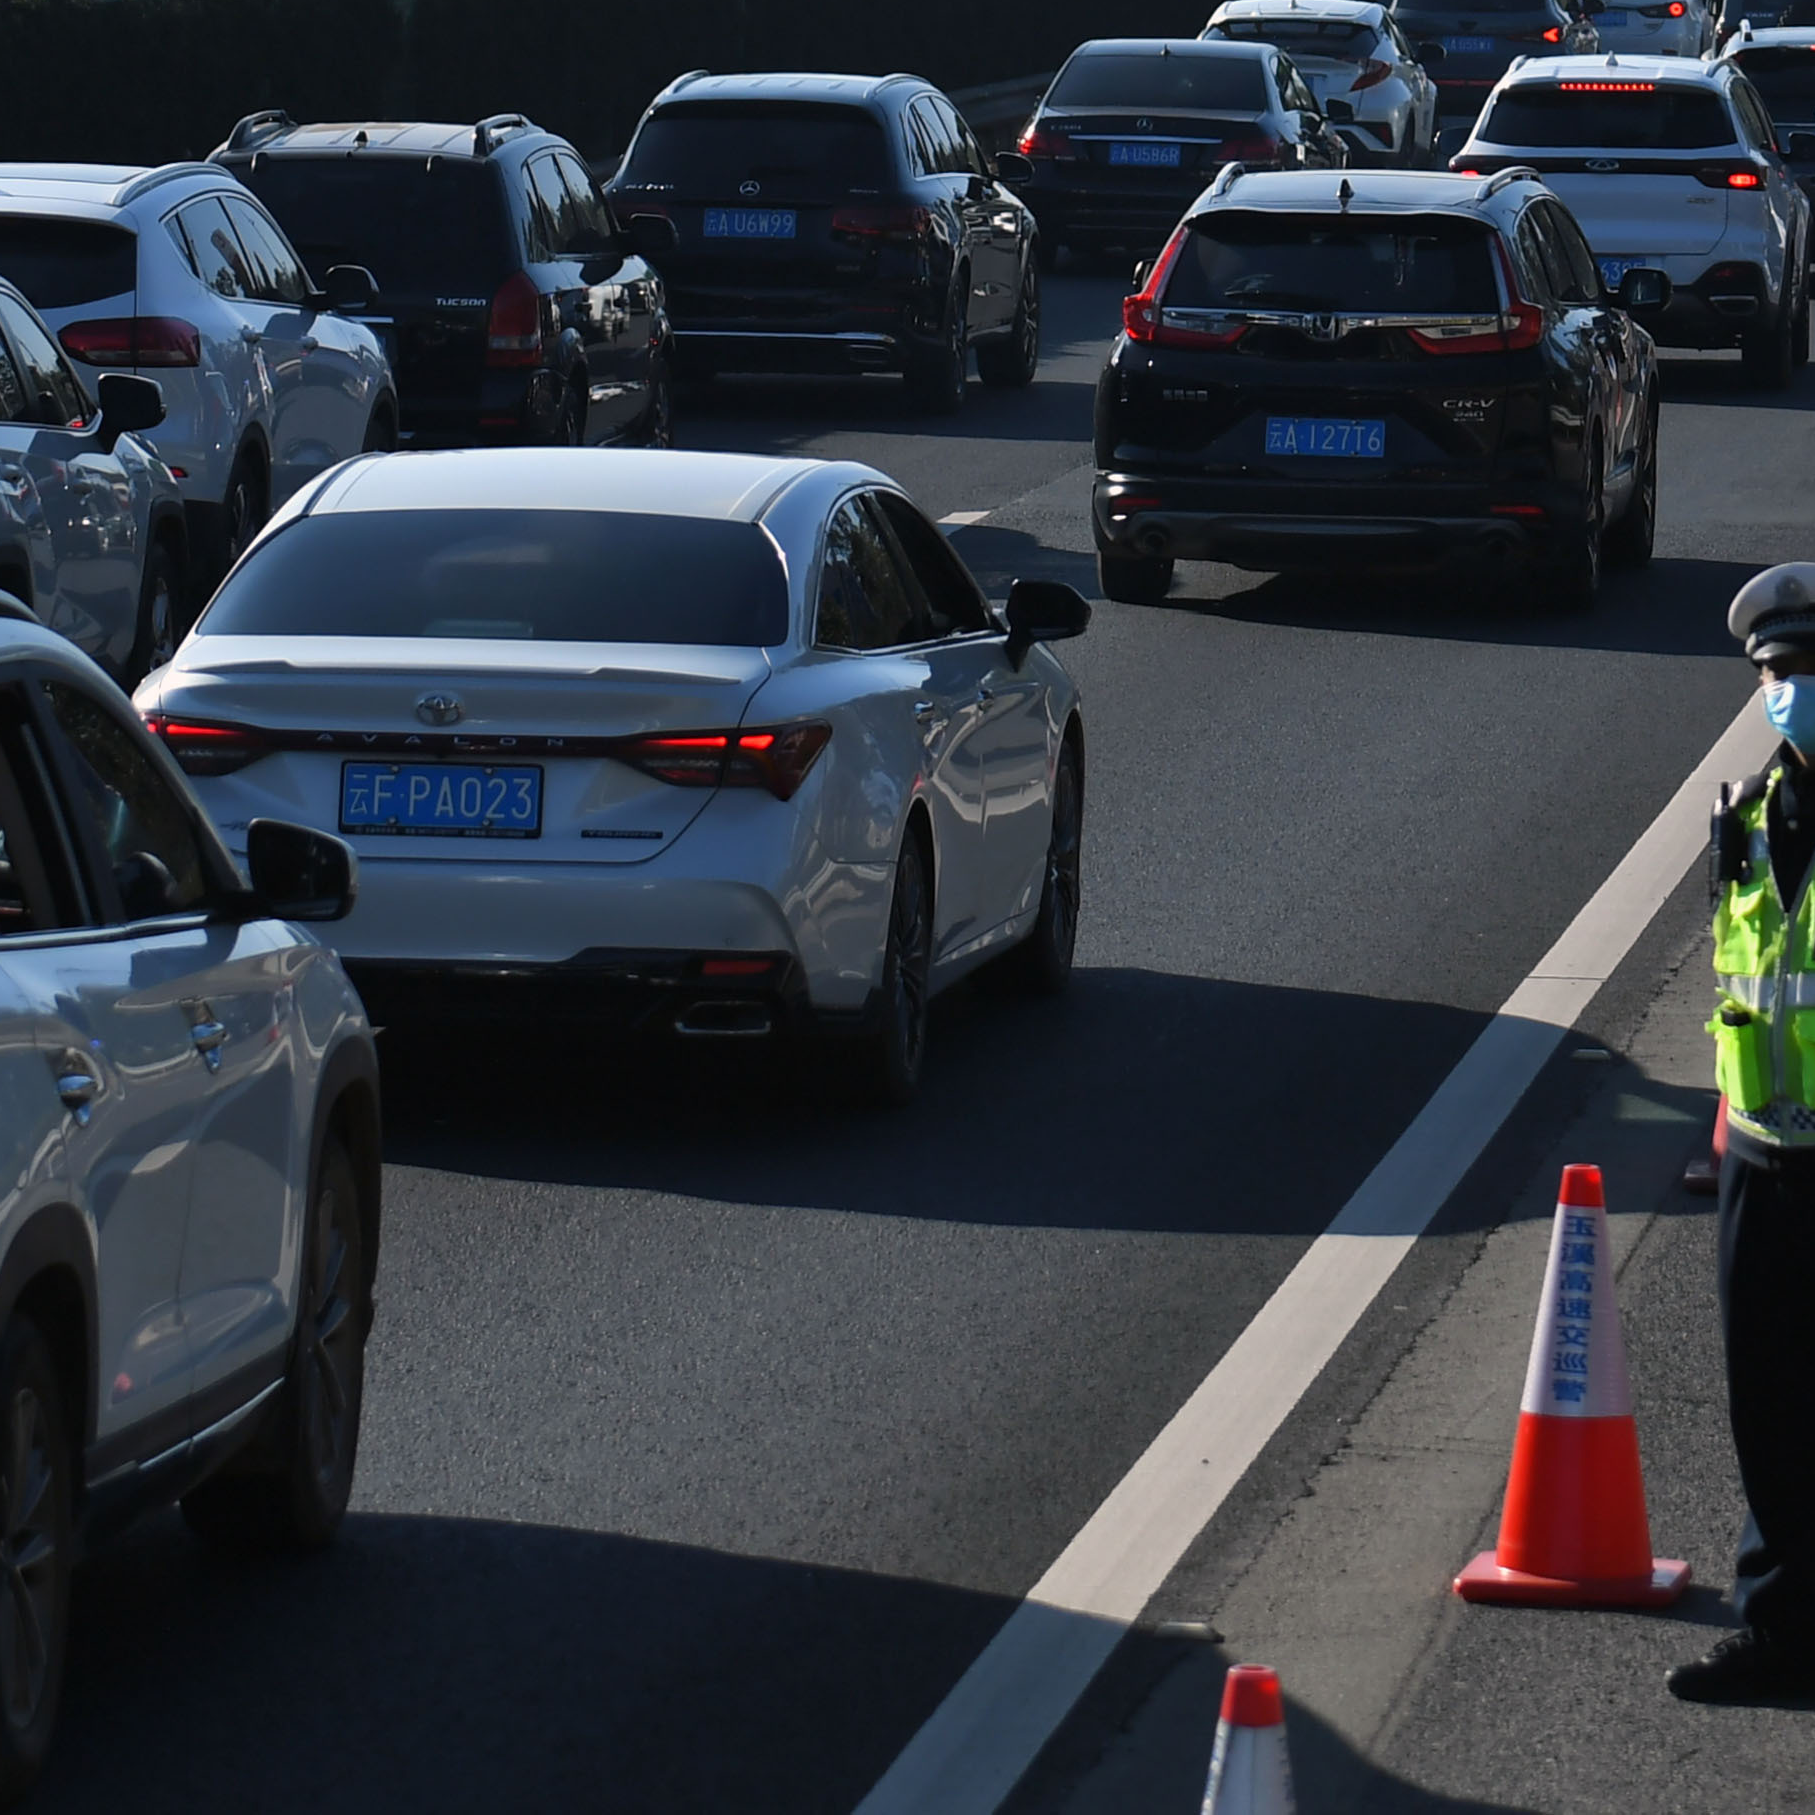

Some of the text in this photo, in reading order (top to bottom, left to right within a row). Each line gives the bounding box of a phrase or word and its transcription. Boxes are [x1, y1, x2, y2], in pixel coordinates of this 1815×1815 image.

[1442, 398, 1496, 409] CR-V
[315, 733, 564, 747] AVALON
[1551, 1215, 1596, 1402] 玉溪高速交巡警
